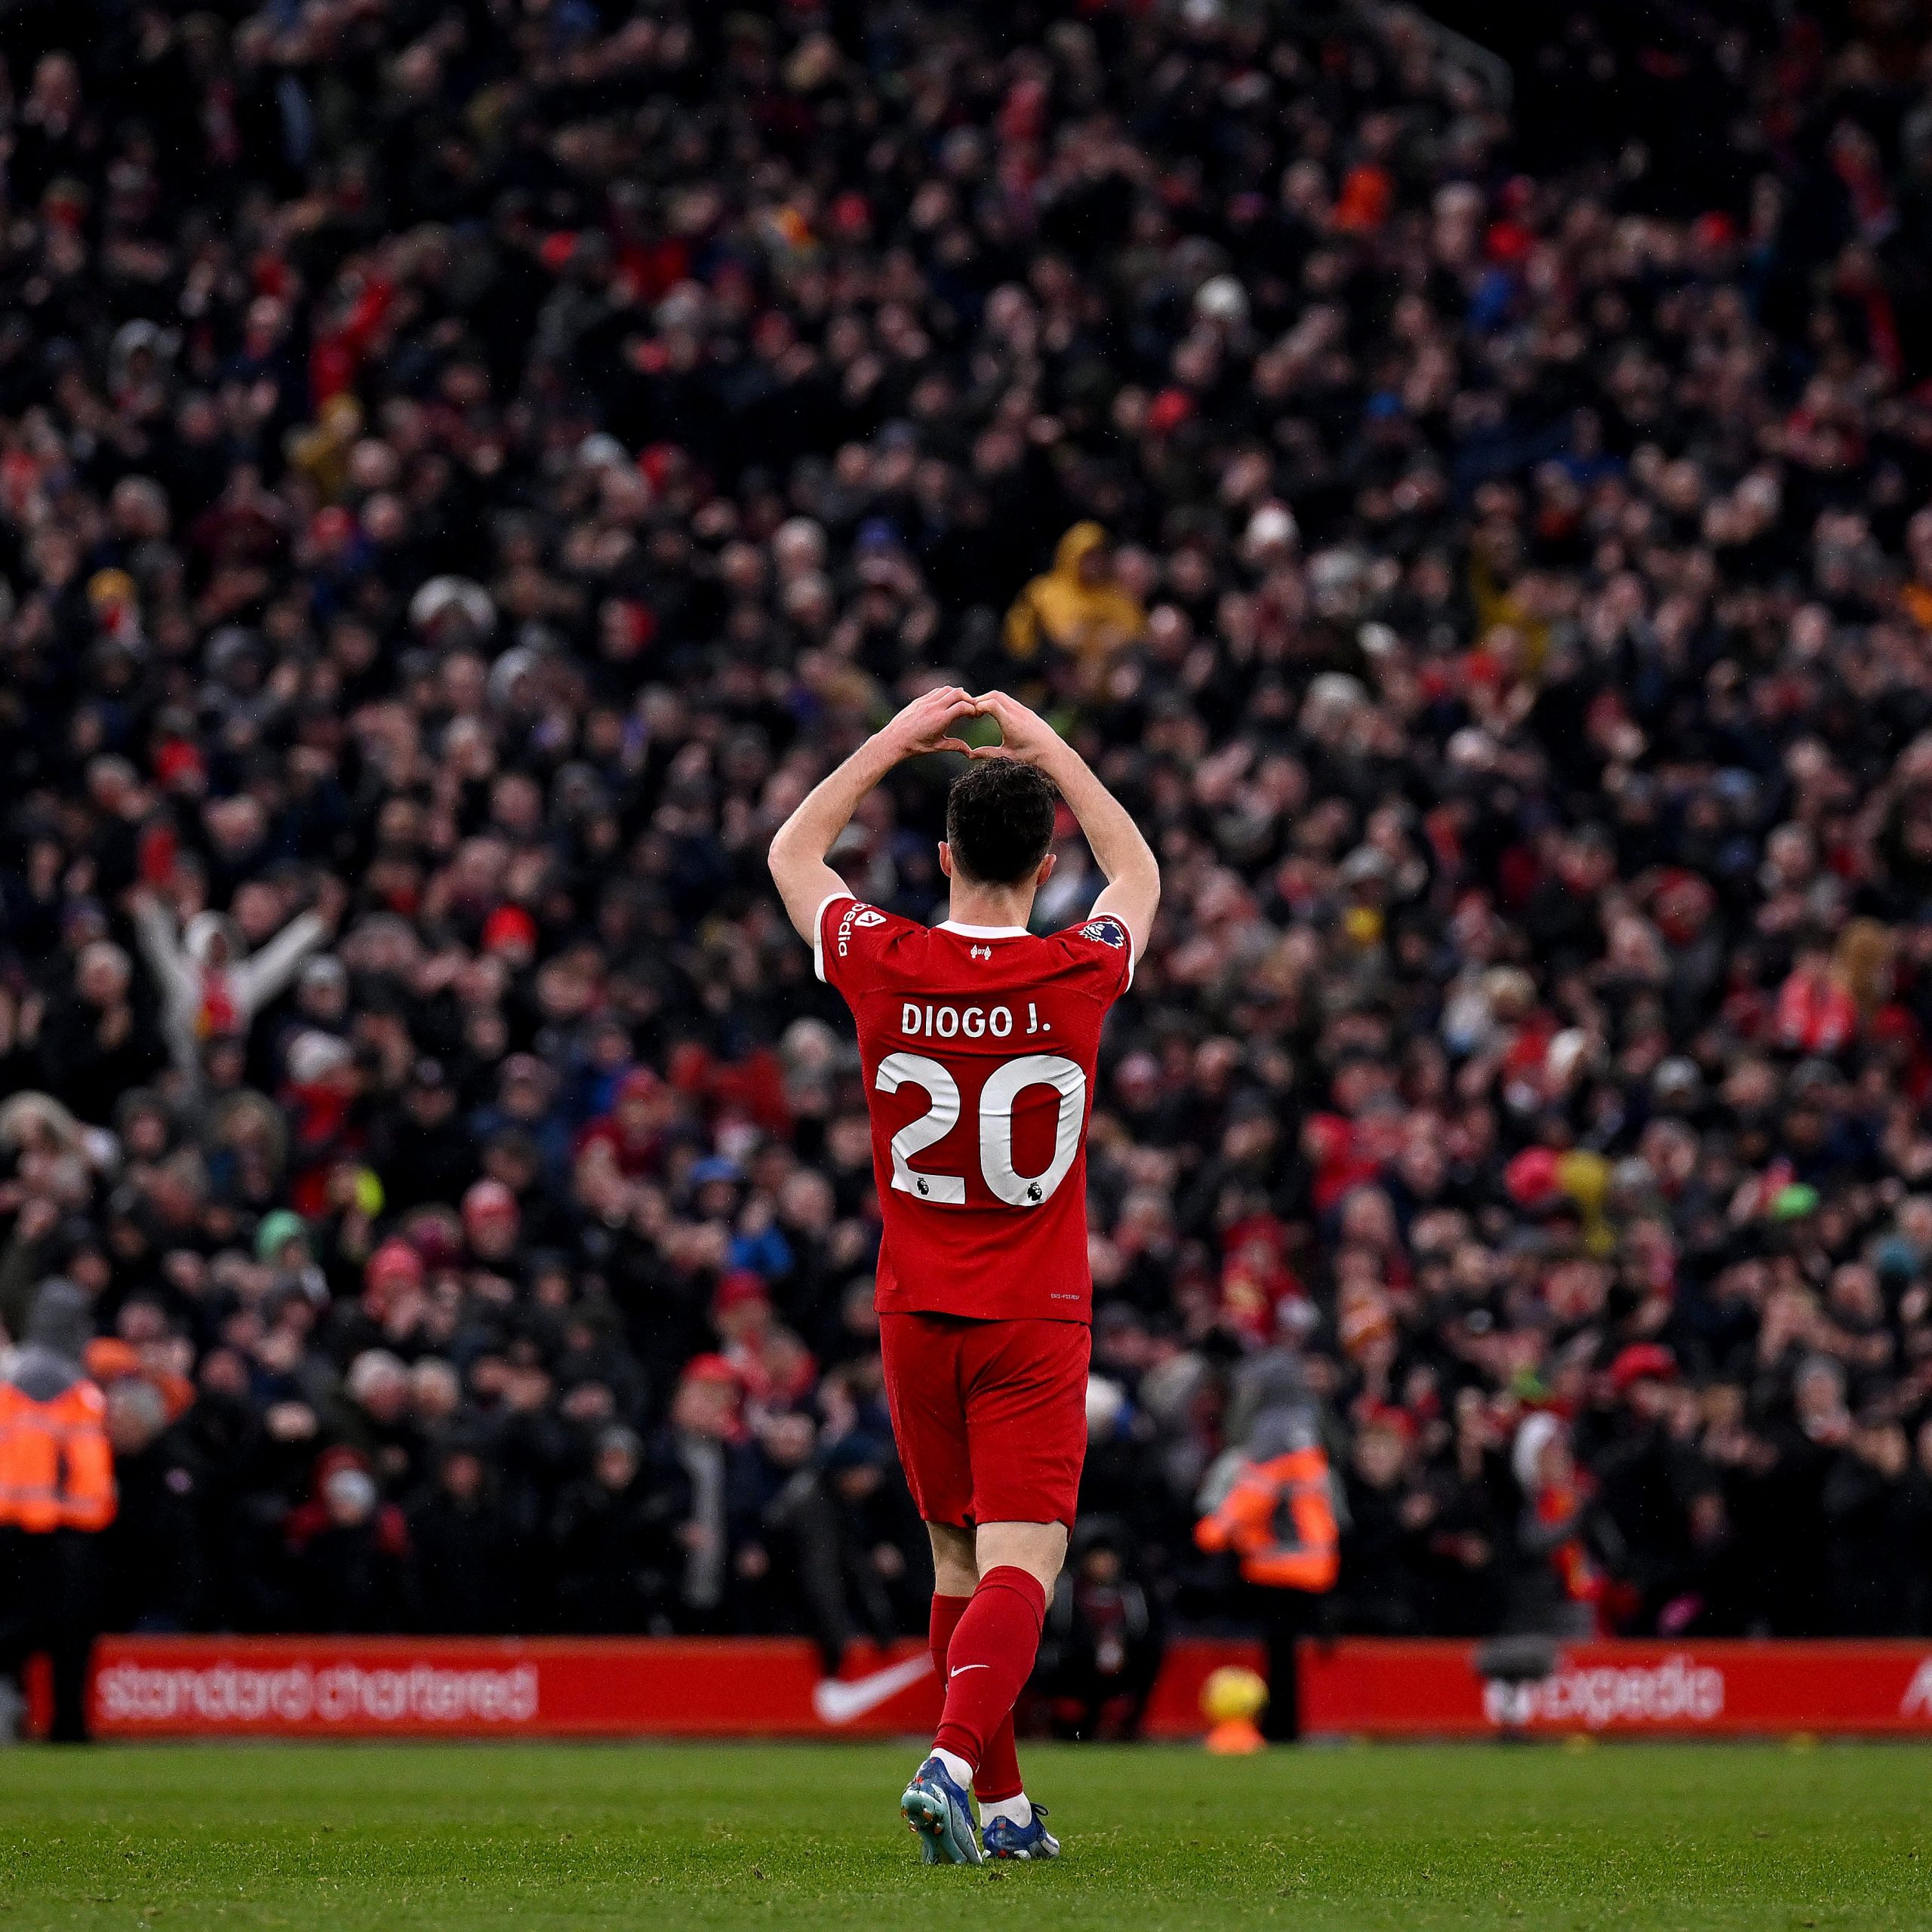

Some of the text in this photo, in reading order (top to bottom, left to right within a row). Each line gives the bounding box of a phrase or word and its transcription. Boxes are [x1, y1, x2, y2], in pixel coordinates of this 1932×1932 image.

[902, 1002, 1051, 1037] DIOGO J.
[875, 1052, 1087, 1206] 20
[99, 1662, 539, 1720] standard chartered
